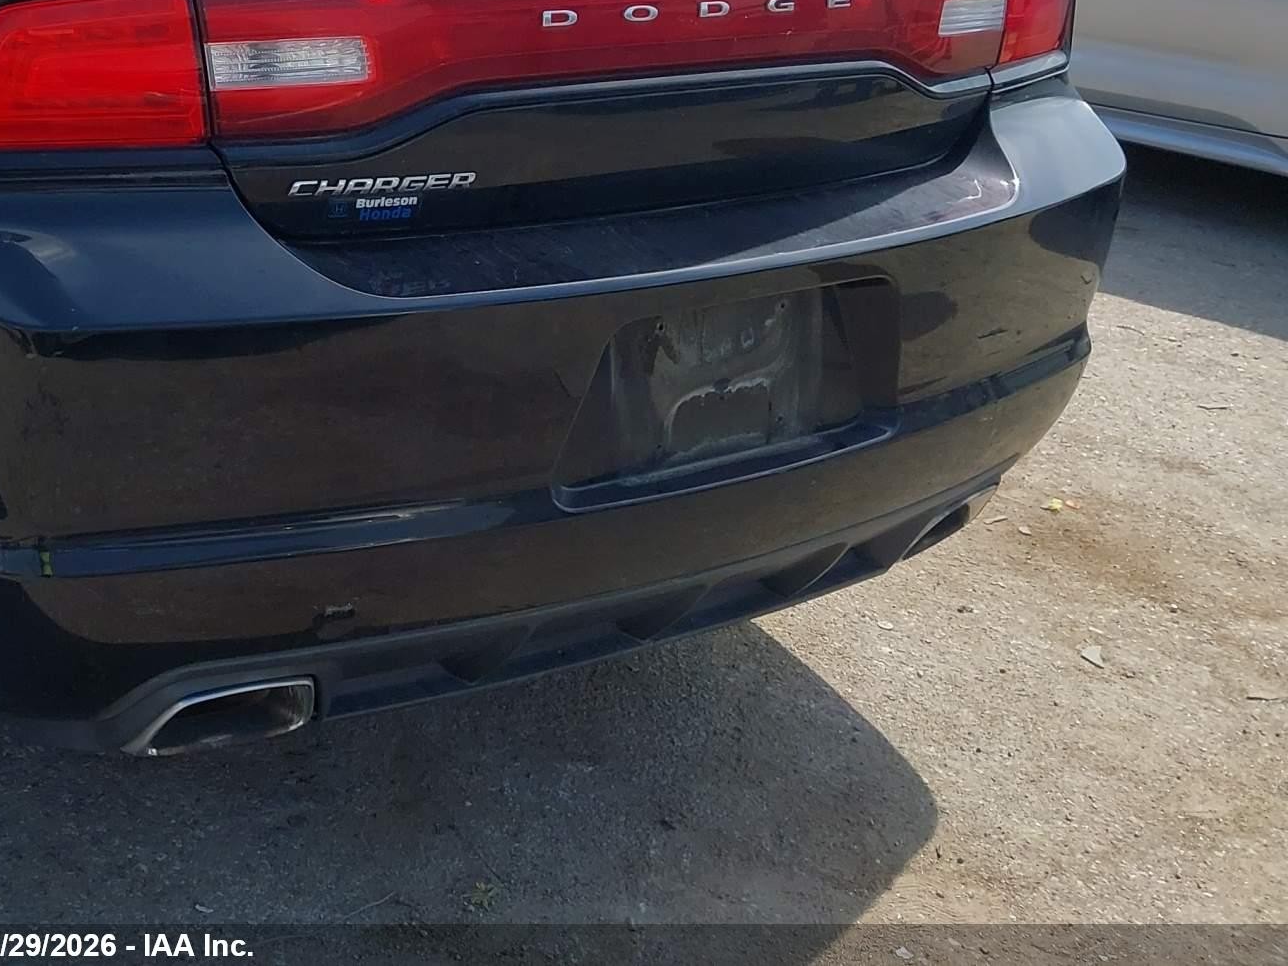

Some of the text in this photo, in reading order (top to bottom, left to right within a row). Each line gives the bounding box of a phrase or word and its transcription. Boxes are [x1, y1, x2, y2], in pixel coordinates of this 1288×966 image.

[288, 172, 477, 197] CHARGER
[355, 196, 418, 209] Burleson
[359, 206, 412, 221] Honda
